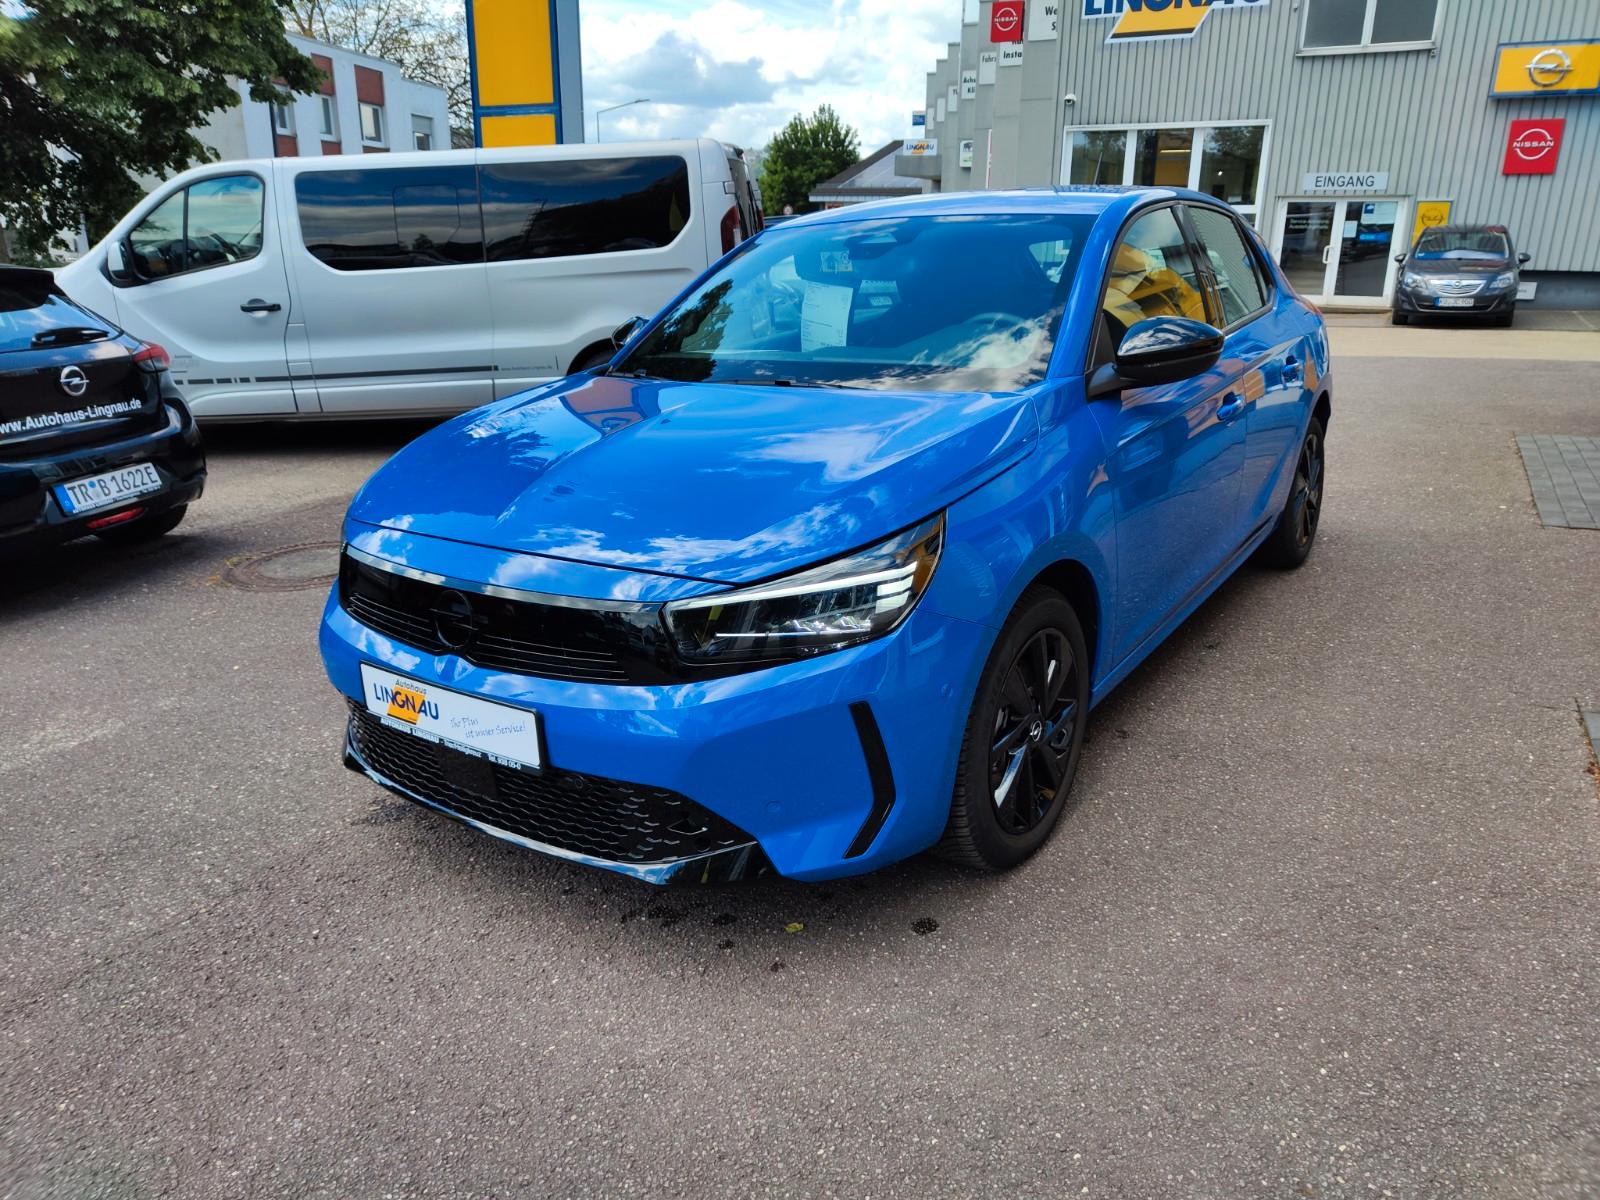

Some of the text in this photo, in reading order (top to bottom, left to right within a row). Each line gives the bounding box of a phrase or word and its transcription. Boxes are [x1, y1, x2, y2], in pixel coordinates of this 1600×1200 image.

[1513, 140, 1554, 148] NISSAN
[1315, 175, 1375, 187] EINGANG
[67, 483, 95, 505] TR
[97, 478, 111, 497] B
[110, 465, 159, 494] 1622E
[395, 679, 427, 694] Autohaus
[373, 683, 440, 720] LINGNAU
